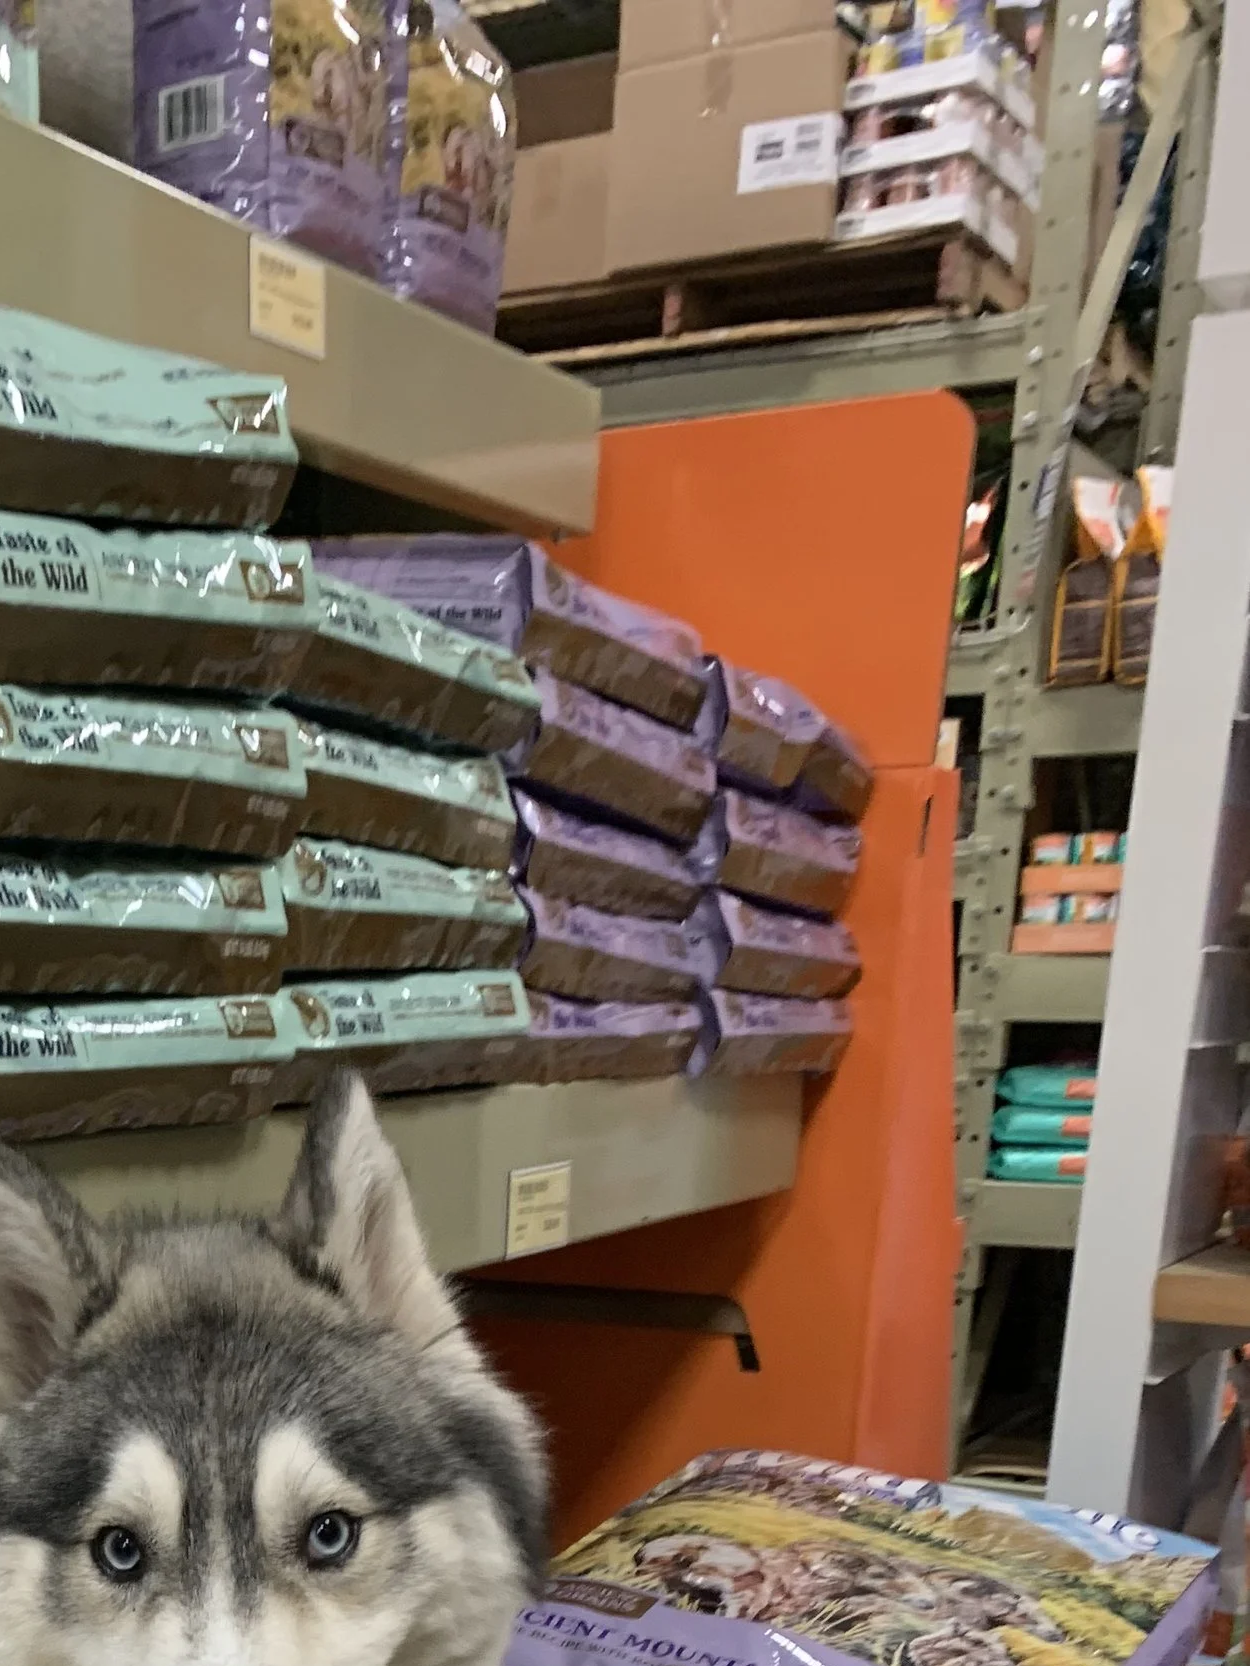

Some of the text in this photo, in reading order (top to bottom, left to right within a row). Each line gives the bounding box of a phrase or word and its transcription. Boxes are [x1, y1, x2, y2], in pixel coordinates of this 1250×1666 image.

[0, 557, 36, 589] the
[40, 559, 89, 594] Wild
[517, 1608, 618, 1642] CIENT
